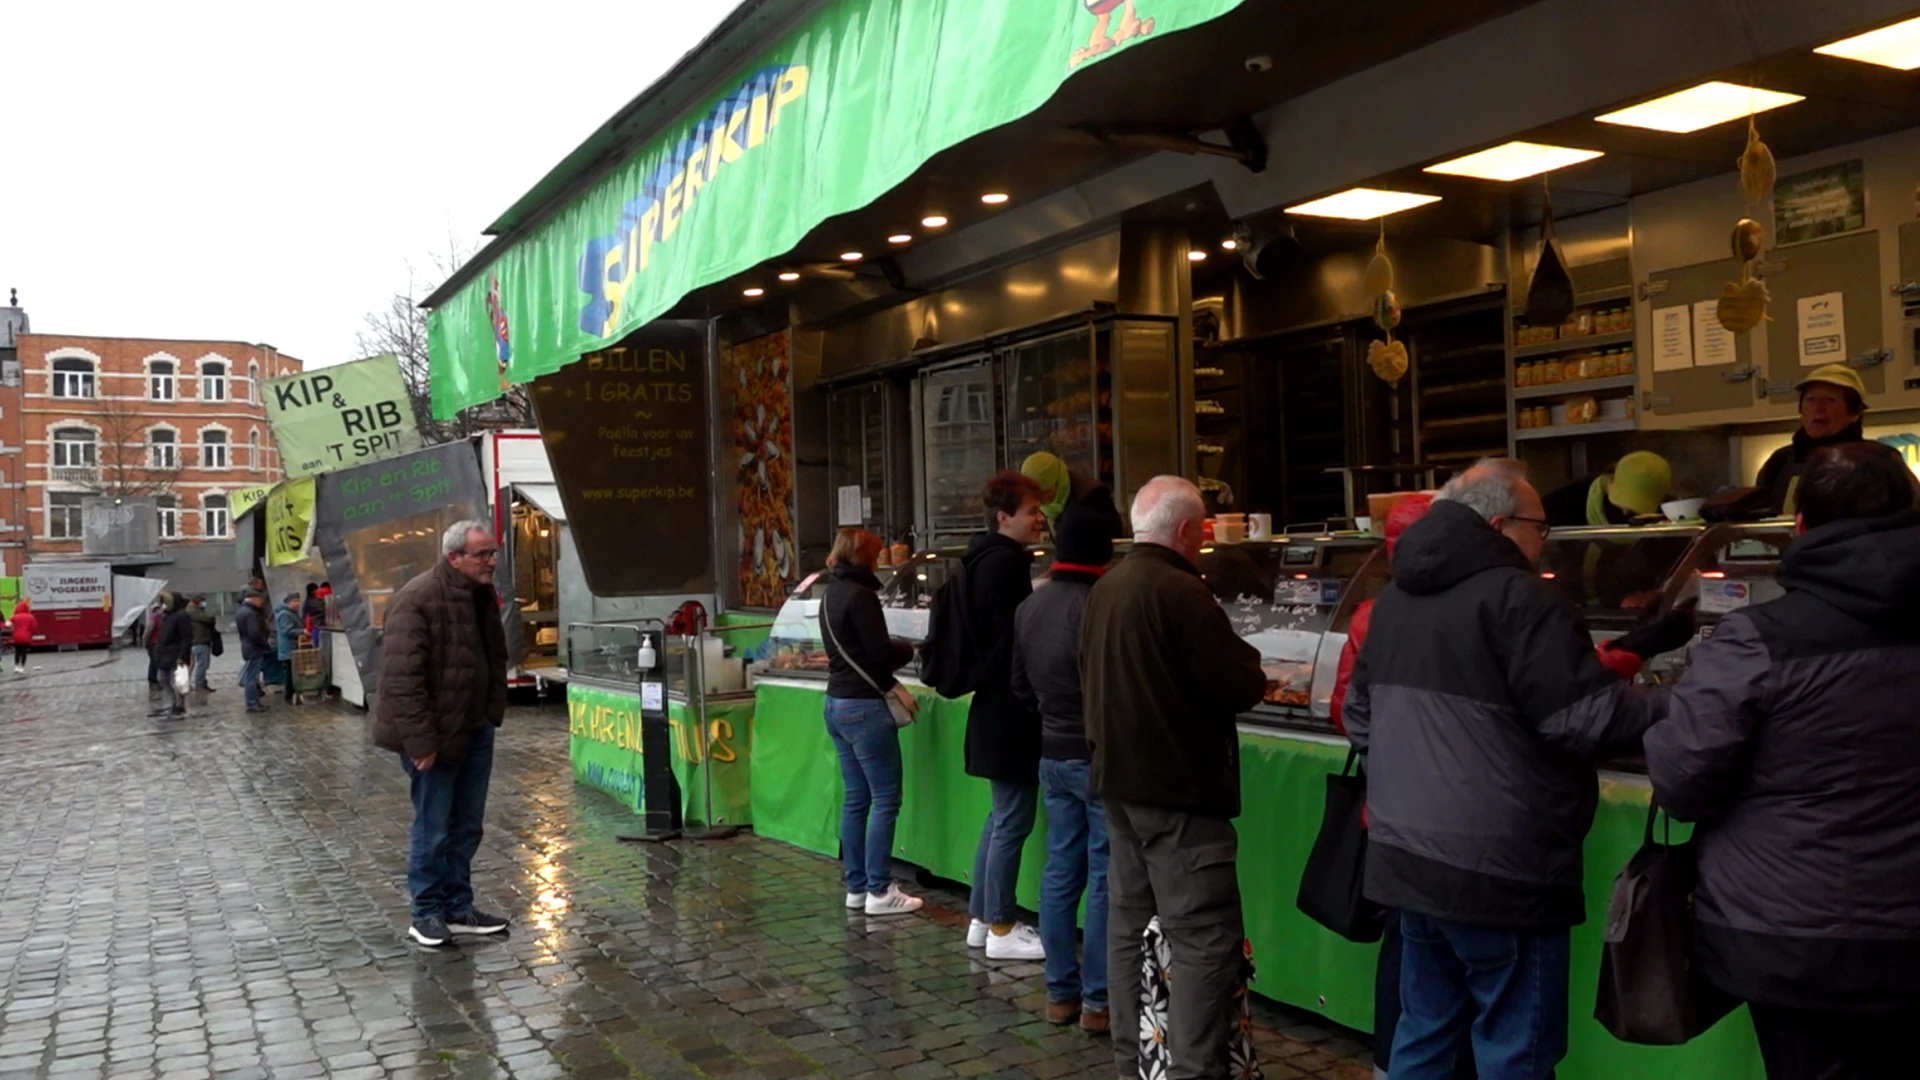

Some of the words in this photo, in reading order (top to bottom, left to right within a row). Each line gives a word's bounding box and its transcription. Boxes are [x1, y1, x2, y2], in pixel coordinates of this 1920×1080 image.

[590, 65, 810, 338] SUPERKIP
[274, 374, 335, 411] KIP
[332, 392, 348, 410] &
[583, 382, 594, 402] 1
[600, 382, 693, 402] GRATIS
[341, 400, 403, 437] RIB
[598, 425, 638, 439] Paella
[642, 428, 671, 439] voor
[675, 428, 695, 439] uw
[301, 458, 323, 471] aan
[325, 443, 344, 462] 'T
[352, 430, 403, 458] SPIT
[613, 444, 673, 461] feestjes
[340, 477, 372, 497] Kip
[379, 468, 408, 487] en
[411, 457, 443, 478] Rib
[242, 488, 266, 503] KIP
[343, 498, 385, 520] aan
[408, 477, 455, 503] Spit
[582, 485, 696, 502] www.superkip.be
